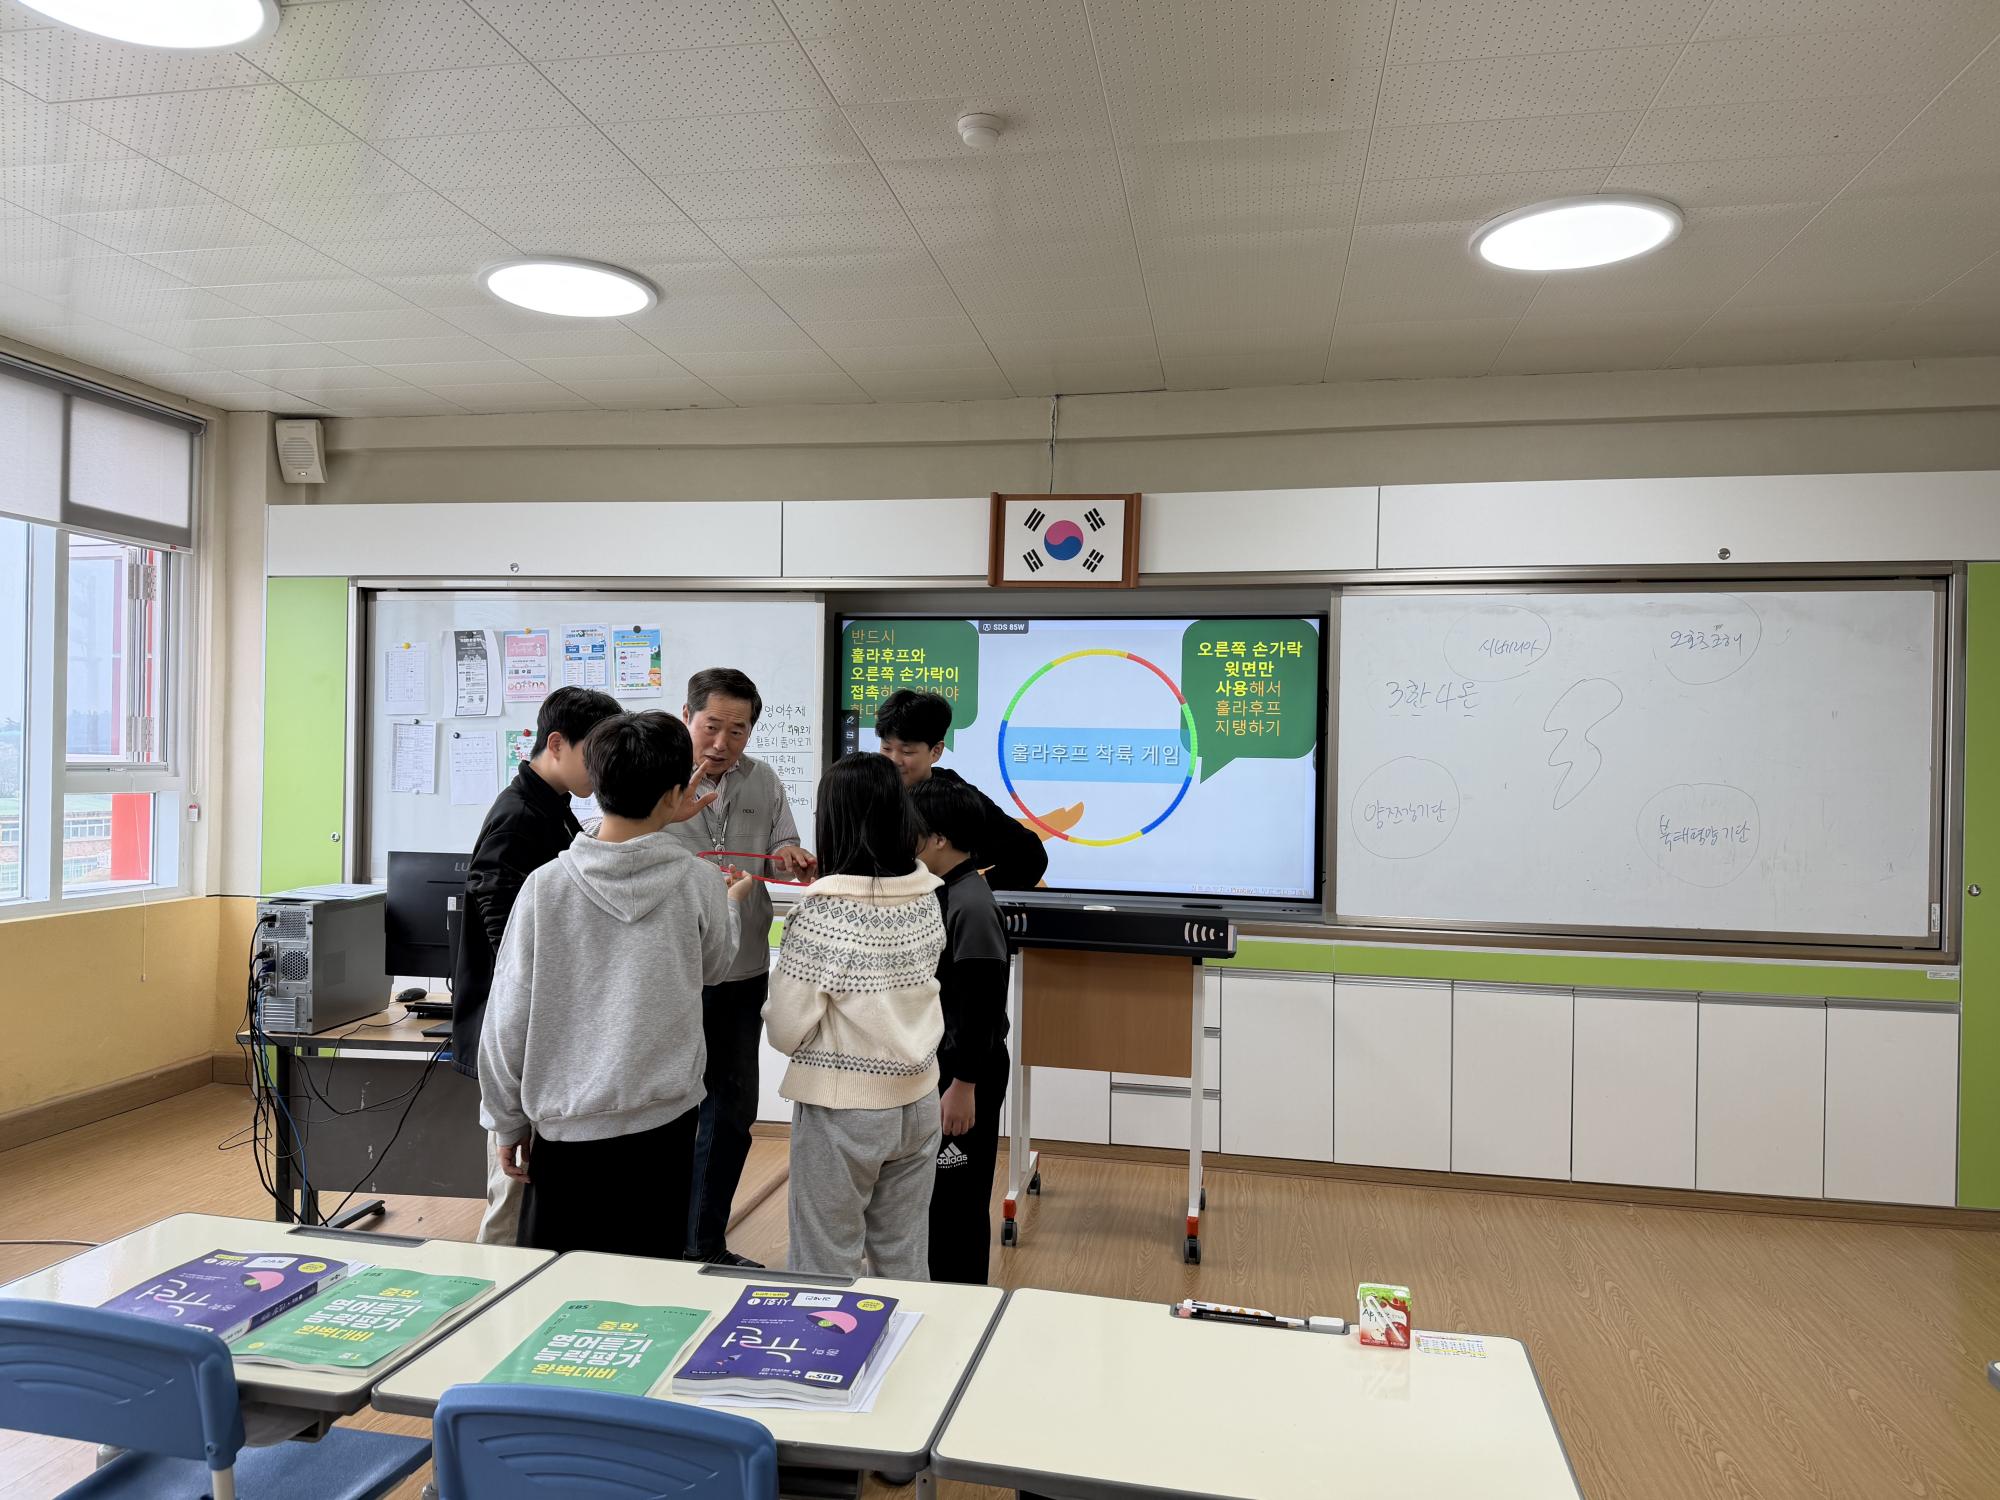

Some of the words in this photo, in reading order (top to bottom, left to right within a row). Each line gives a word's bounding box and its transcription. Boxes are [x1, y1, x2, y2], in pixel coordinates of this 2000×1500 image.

[993, 623, 1008, 631] SDS
[1009, 623, 1025, 631] 85W
[851, 628, 895, 645] 반드시
[851, 648, 926, 664] 훌라후프와
[1197, 641, 1247, 658] 오른쪽
[1252, 641, 1303, 658] 손가락
[850, 666, 895, 682] 오른쪽
[899, 666, 959, 683] 손가락이
[1224, 660, 1275, 678] 윗면만
[850, 685, 909, 701] 접촉하
[1215, 680, 1281, 697] 사용해서
[1215, 700, 1281, 717] 훌라후프
[1215, 719, 1281, 737] 지탱하기
[1010, 743, 1089, 764] 훌라후프
[1095, 744, 1135, 766] 착륙
[1141, 745, 1181, 767] 게임
[937, 1154, 968, 1165] adidas
[324, 1299, 424, 1318] 영어듣기
[303, 1311, 405, 1332] 능력평가
[597, 1320, 640, 1331] 중학
[548, 1334, 653, 1353] 영어듣기
[533, 1347, 642, 1368] 능력평가
[531, 1363, 618, 1380] 완벽대비
[815, 1373, 840, 1382] EBS
